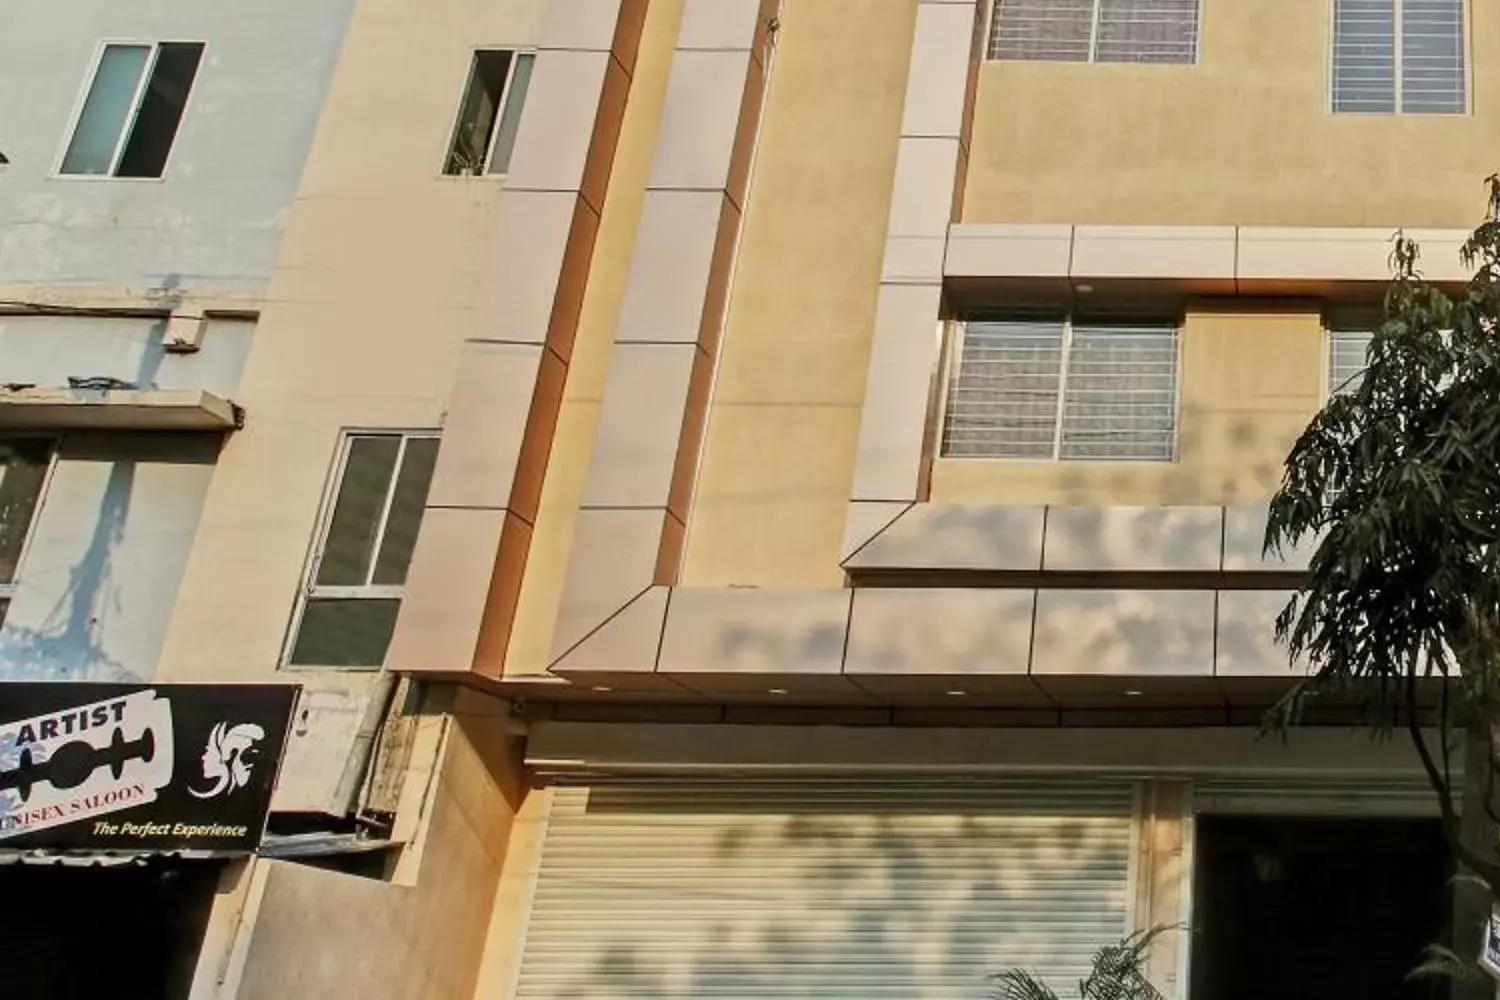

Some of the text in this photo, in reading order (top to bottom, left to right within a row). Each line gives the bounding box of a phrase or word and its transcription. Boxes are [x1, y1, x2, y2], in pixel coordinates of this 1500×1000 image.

[15, 701, 127, 747] ARTIST
[70, 784, 145, 812] SALOON
[93, 821, 248, 838] The Perfect Experience
